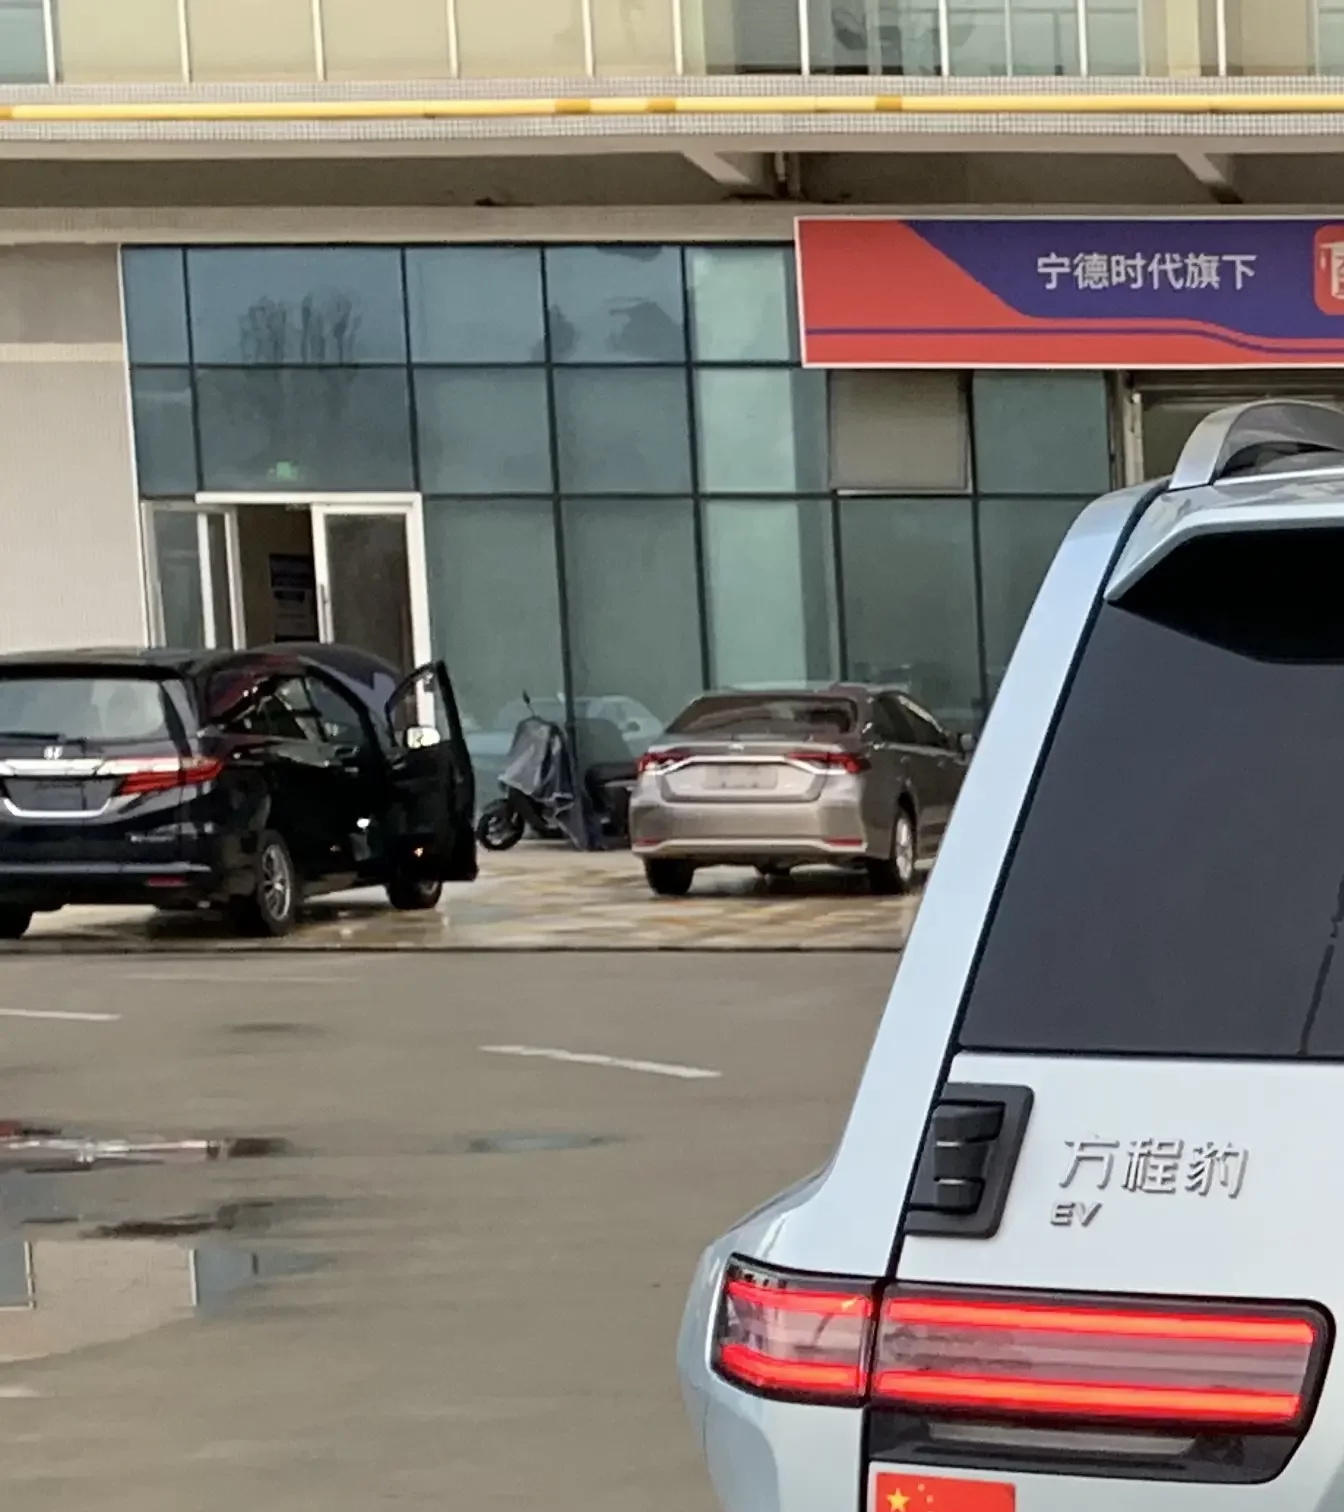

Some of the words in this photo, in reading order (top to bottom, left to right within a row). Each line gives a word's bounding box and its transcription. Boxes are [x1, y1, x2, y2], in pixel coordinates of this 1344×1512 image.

[1037, 252, 1257, 290] 宁德时代旗下
[1059, 1134, 1250, 1198] 方程豹
[1050, 1202, 1102, 1226] EV
